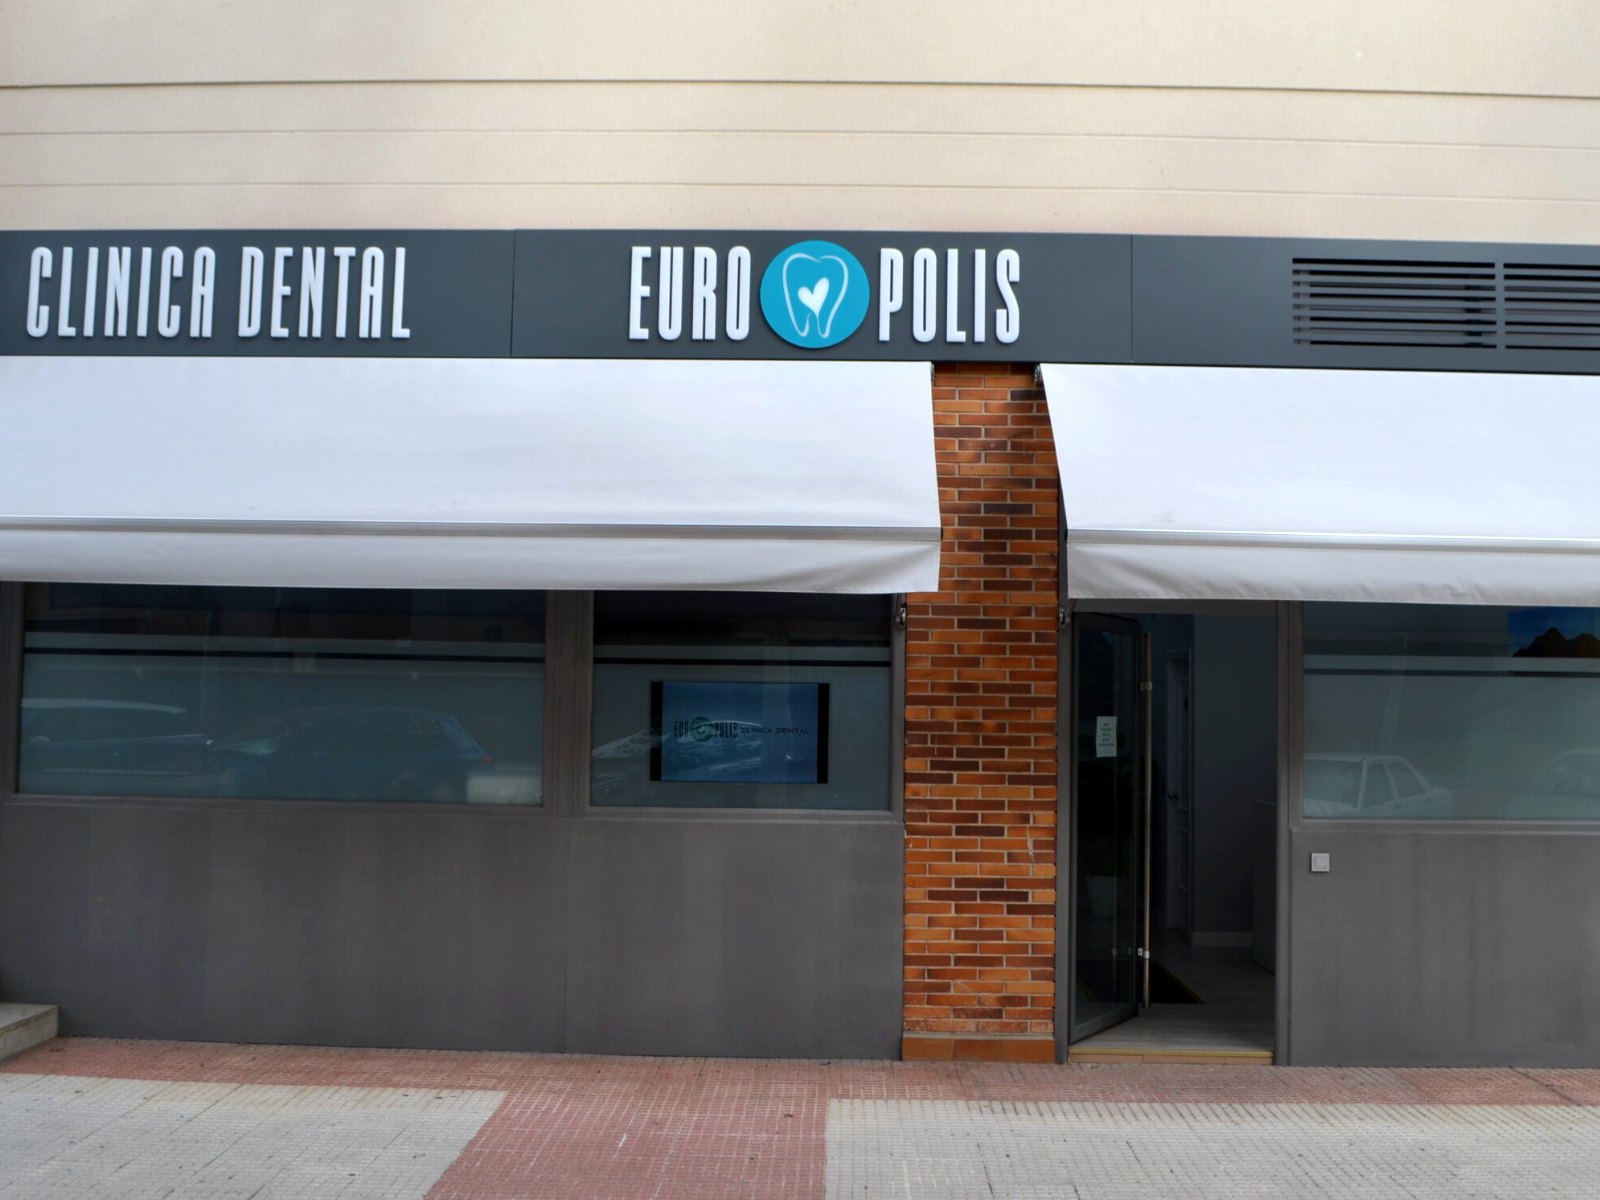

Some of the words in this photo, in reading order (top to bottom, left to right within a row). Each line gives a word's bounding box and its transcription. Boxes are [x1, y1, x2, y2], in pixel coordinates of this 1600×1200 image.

[27, 246, 217, 338] CLINICA
[238, 246, 411, 339] DENTAL
[629, 245, 752, 341] EURO
[879, 247, 1021, 343] POLIS
